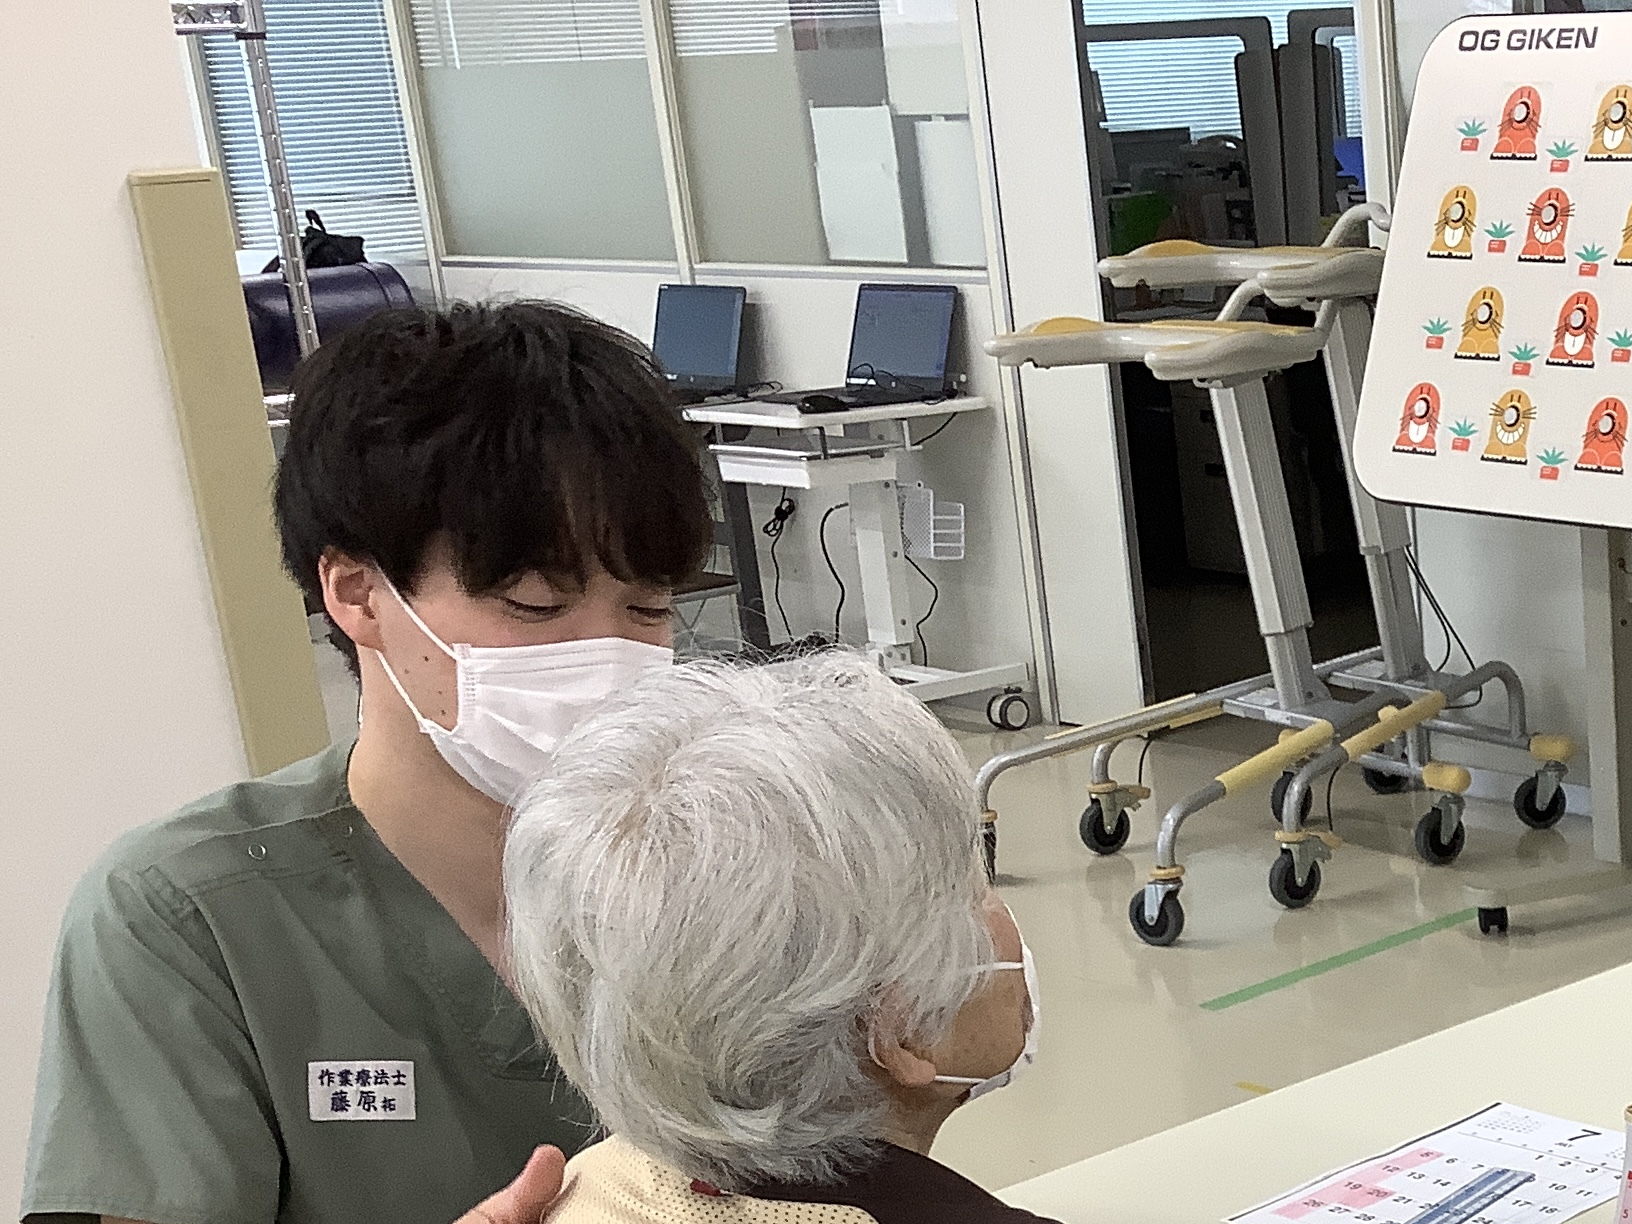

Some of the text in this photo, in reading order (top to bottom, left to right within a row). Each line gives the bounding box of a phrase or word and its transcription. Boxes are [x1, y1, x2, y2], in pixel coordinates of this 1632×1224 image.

[1459, 26, 1599, 51] OG GIKEN
[318, 1068, 407, 1087] 作業療法士
[1567, 1128, 1602, 1142] 7
[1407, 1171, 1425, 1180] 13
[1432, 1178, 1451, 1187] 14
[1511, 1199, 1532, 1207] 17
[1548, 1182, 1567, 1191] 10
[1575, 1189, 1593, 1197] 11
[1328, 1206, 1351, 1214] 27
[1344, 1181, 1363, 1190] 19
[1366, 1189, 1389, 1198] 20
[1392, 1196, 1413, 1204] 21
[1471, 1216, 1493, 1224] 24
[1622, 1209, 1629, 1219] 5
